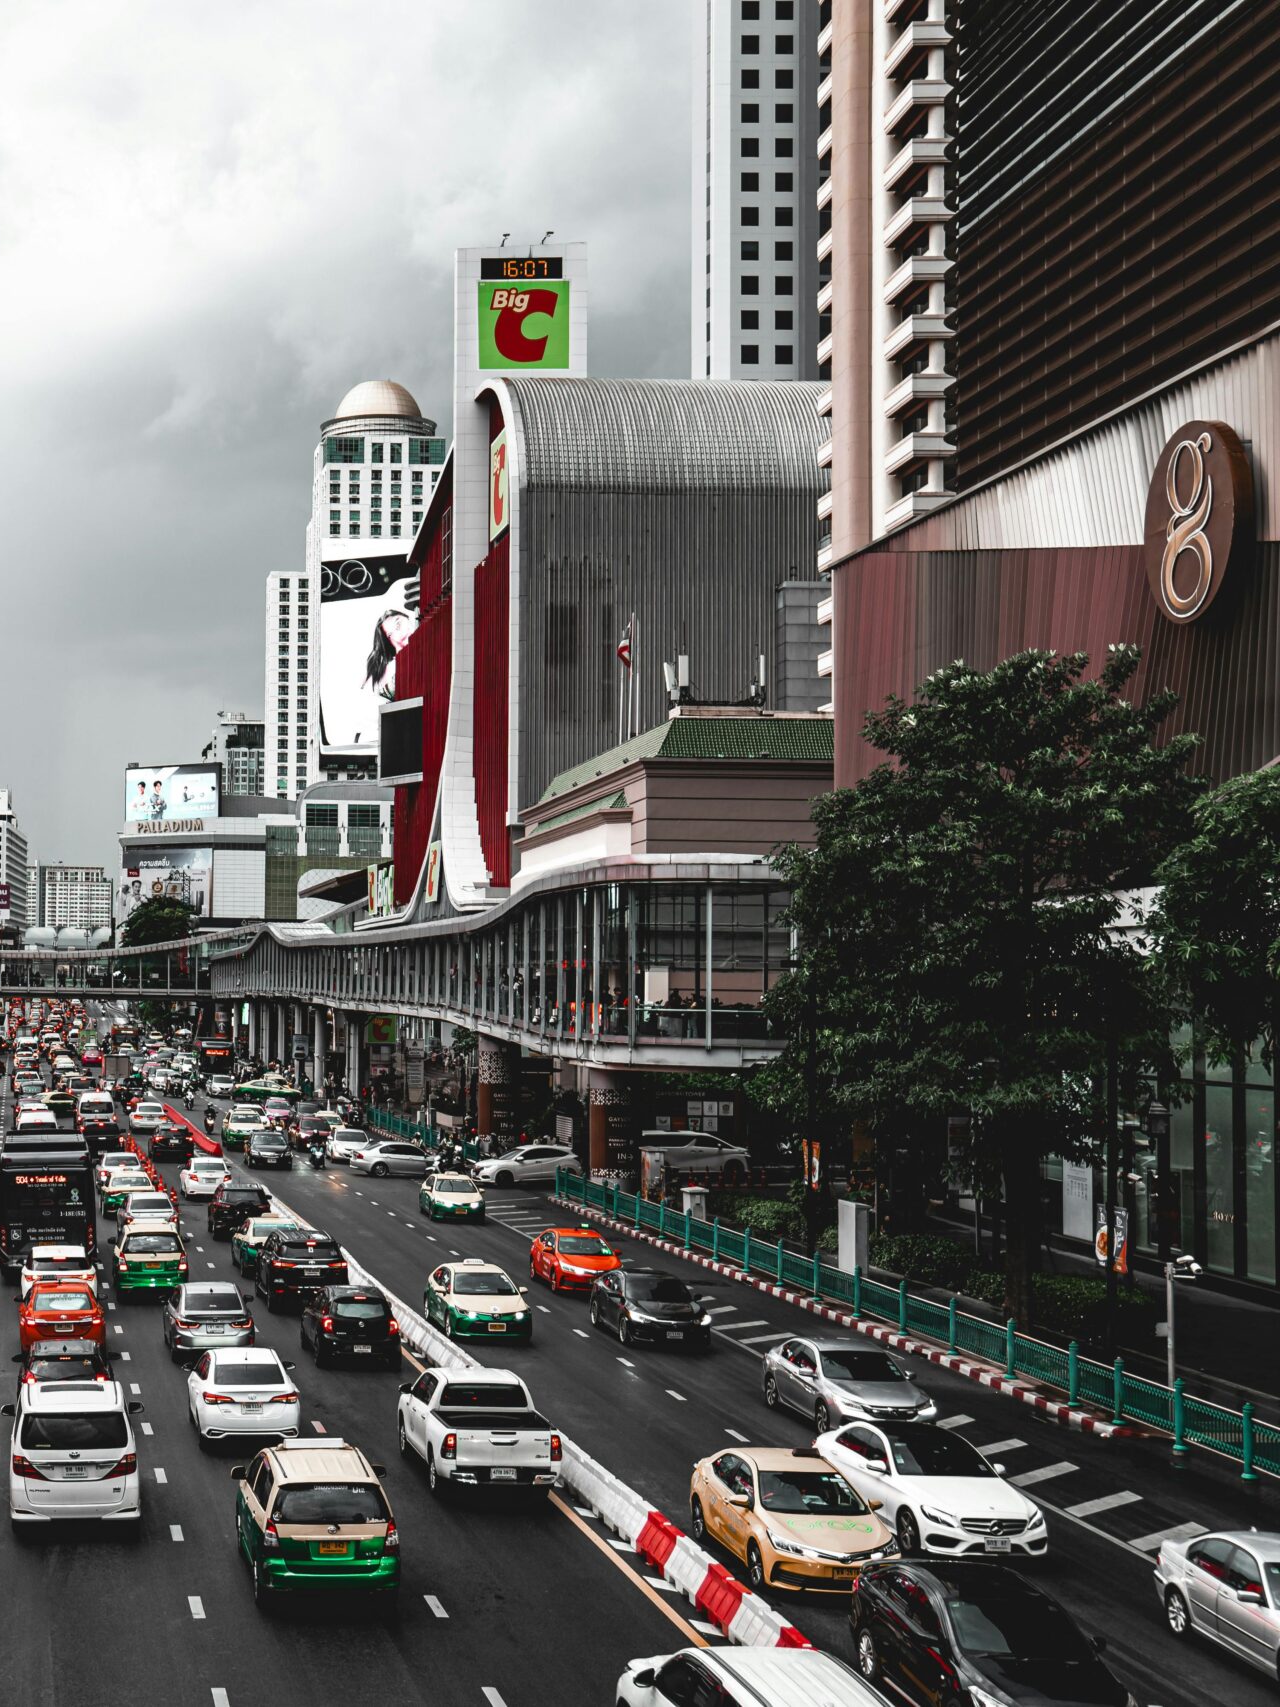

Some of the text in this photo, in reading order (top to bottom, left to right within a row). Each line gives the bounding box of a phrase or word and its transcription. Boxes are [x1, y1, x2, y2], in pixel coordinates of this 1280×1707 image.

[503, 260, 548, 277] 16:07
[492, 289, 530, 313] Big
[494, 288, 558, 362] C
[137, 819, 204, 833] PALLADIUM
[15, 1176, 28, 1184] 504
